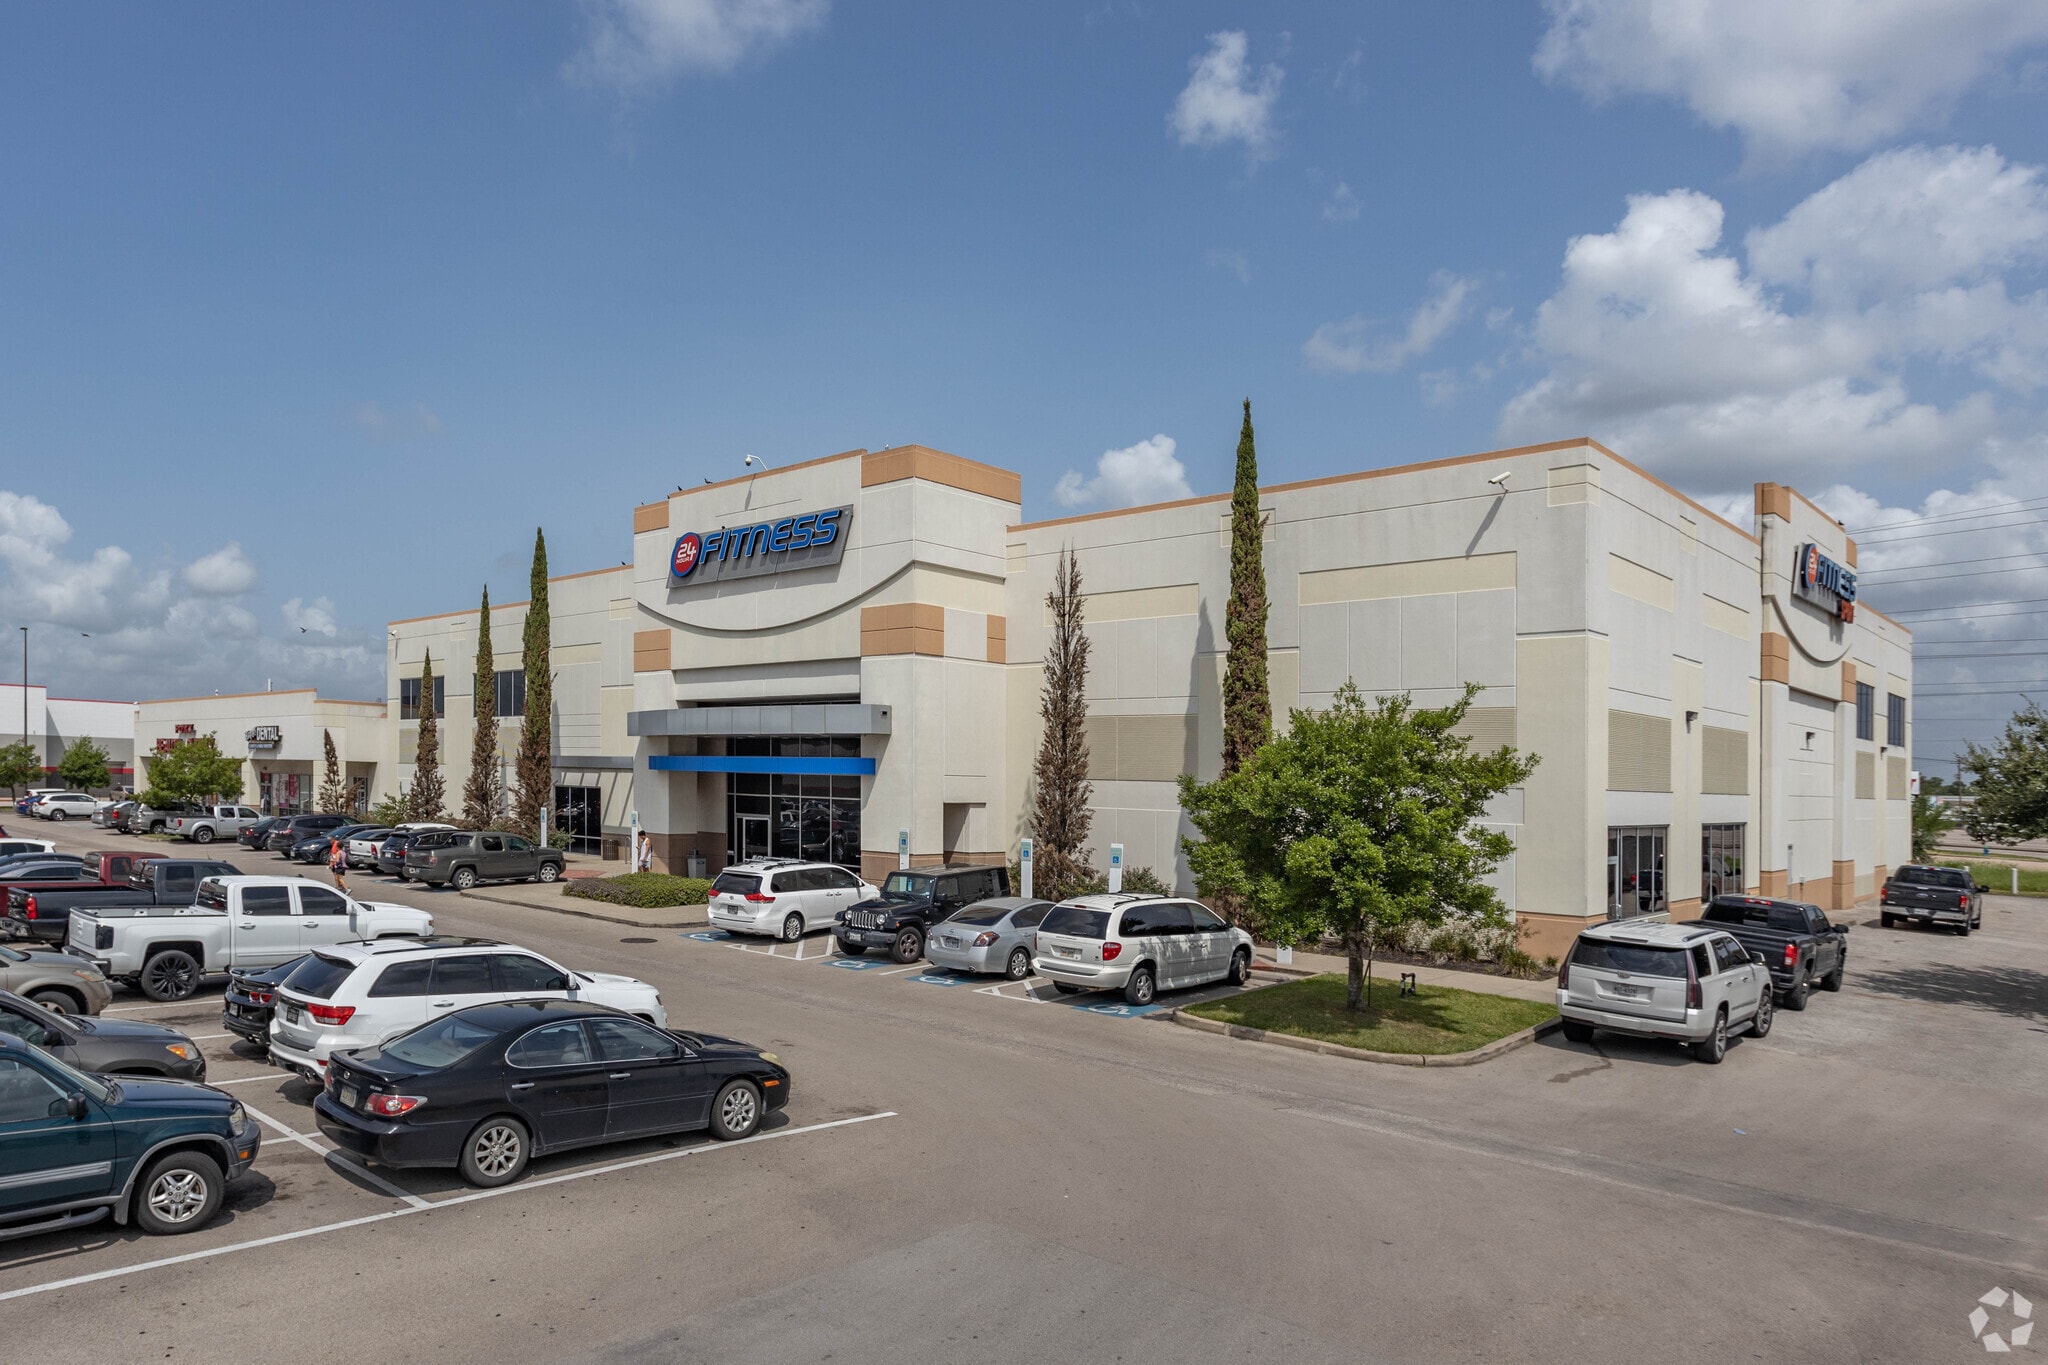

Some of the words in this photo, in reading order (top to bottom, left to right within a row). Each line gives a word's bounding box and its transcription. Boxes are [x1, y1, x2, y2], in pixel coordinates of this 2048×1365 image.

[699, 508, 842, 564] FITNESS
[677, 541, 697, 561] 24
[256, 726, 279, 741] DENTAL
